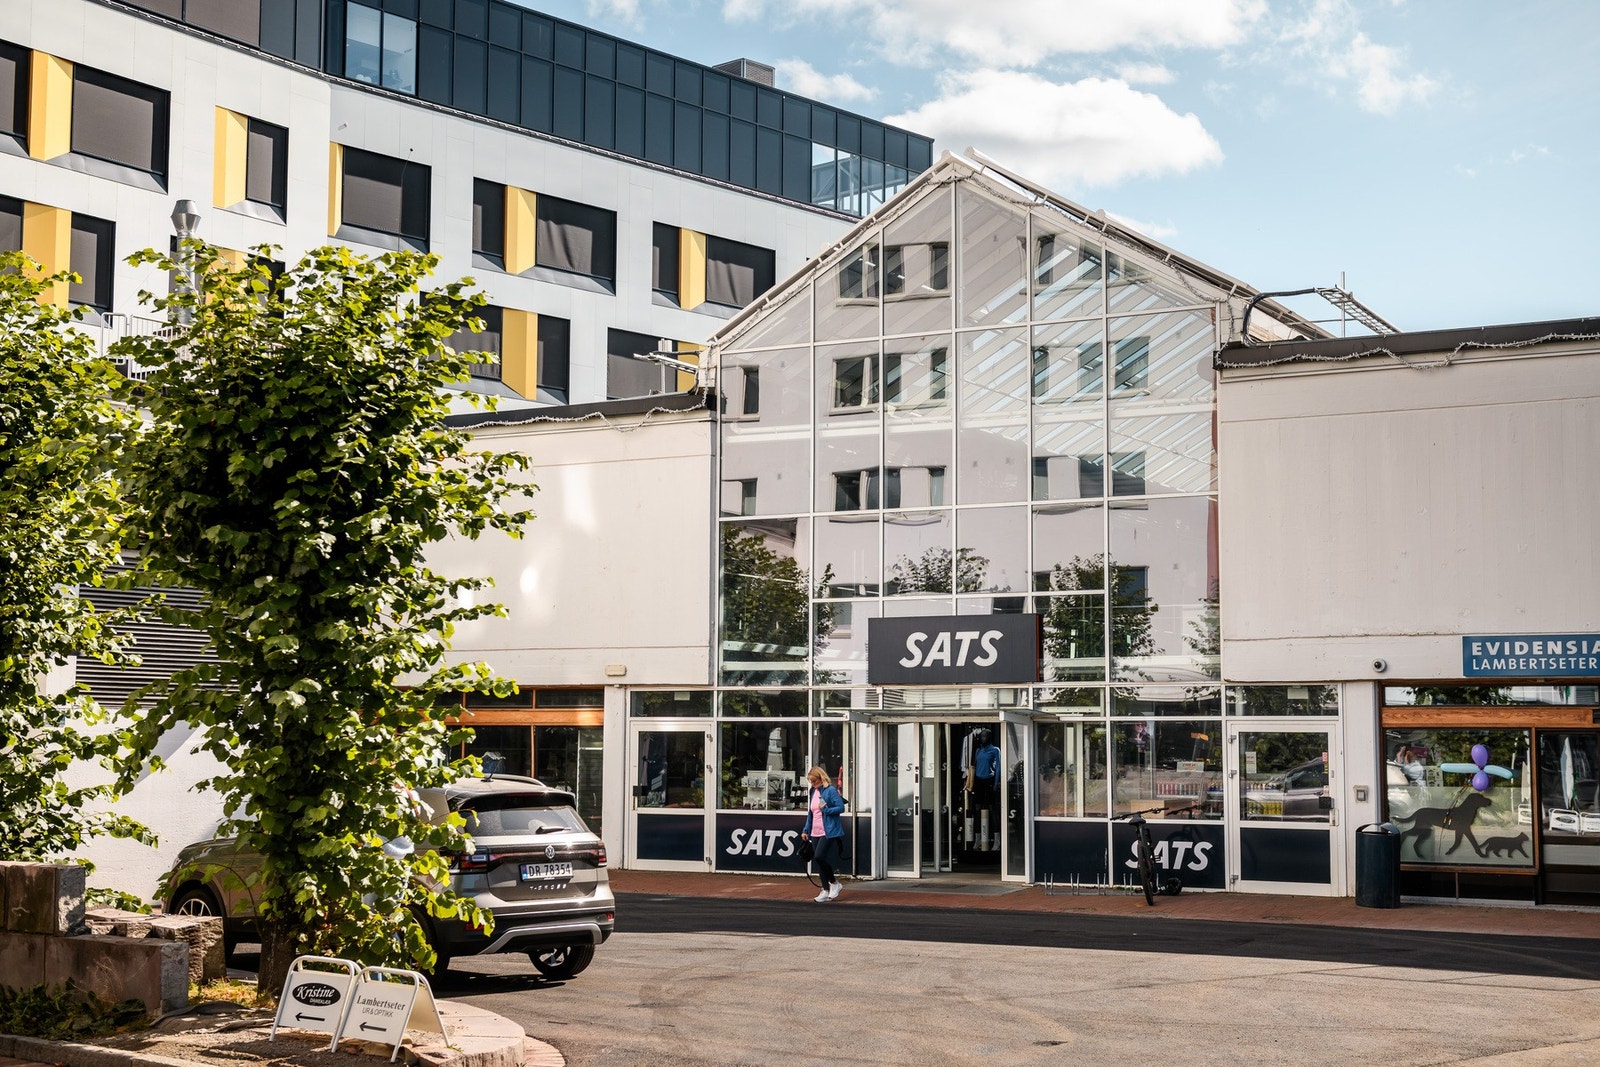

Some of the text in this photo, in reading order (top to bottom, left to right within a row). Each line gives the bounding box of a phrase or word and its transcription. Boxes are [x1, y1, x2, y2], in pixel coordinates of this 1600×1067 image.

[899, 629, 1004, 669] SATS
[1473, 658, 1598, 670] LAMBERTSETER
[725, 828, 799, 858] SATS
[529, 864, 570, 877] DR 78354
[297, 986, 335, 999] Kristine
[356, 995, 406, 1011] Lambertseter
